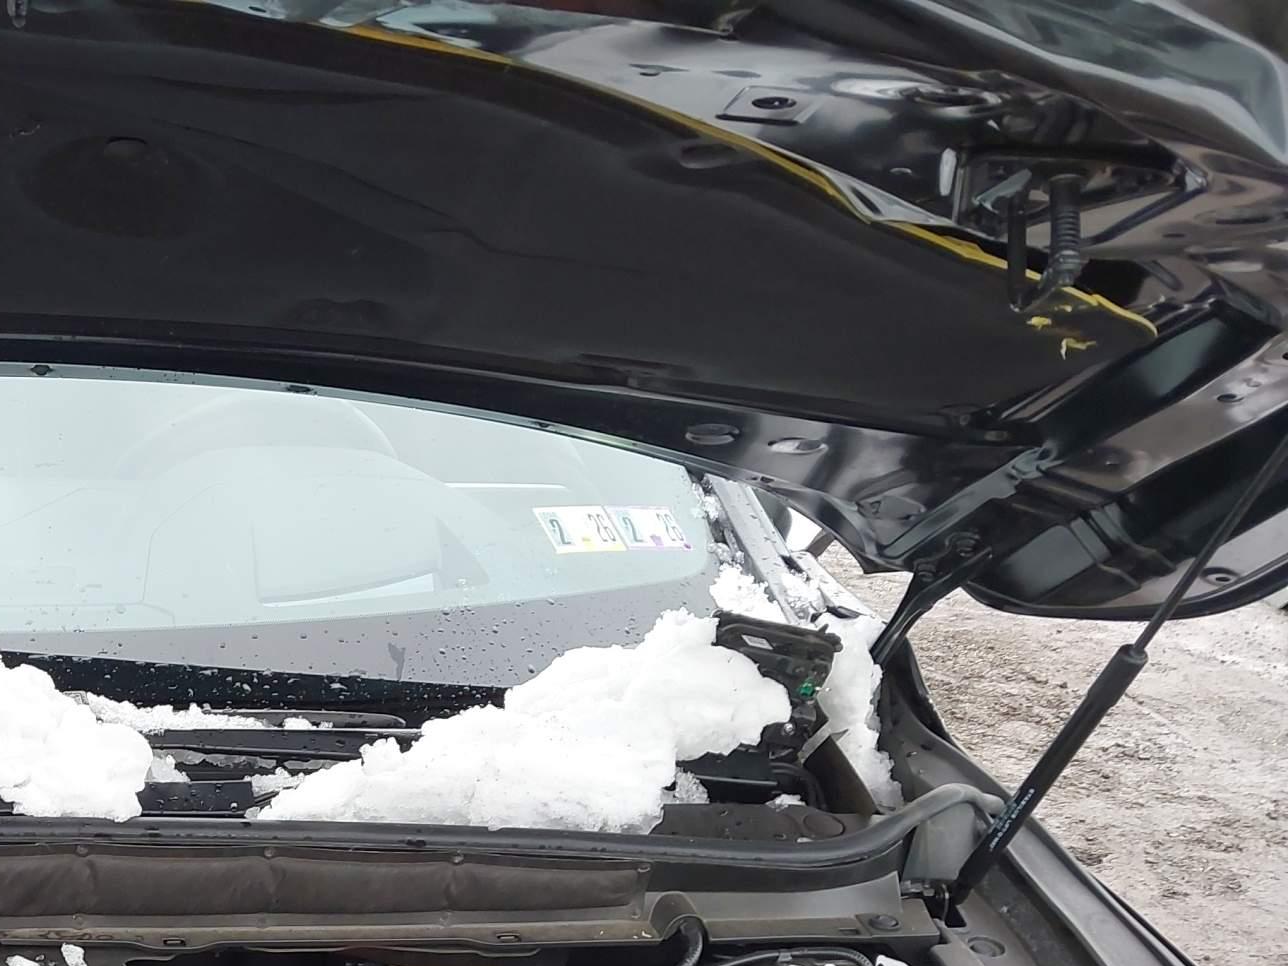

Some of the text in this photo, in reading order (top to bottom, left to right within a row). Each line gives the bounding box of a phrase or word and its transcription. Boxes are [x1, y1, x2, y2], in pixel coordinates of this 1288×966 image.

[549, 513, 617, 545] 2 26
[622, 513, 685, 543] 2 26
